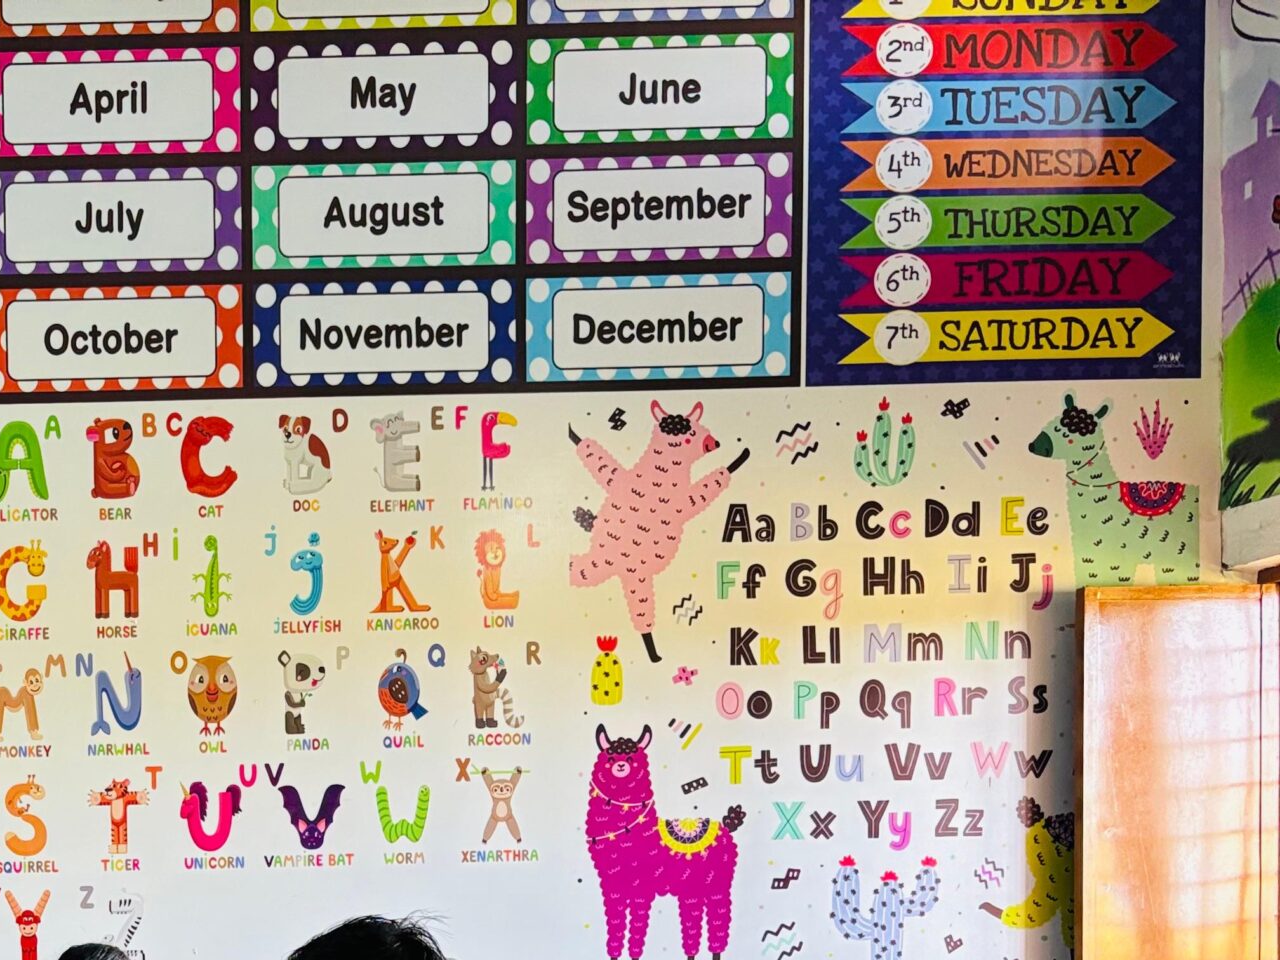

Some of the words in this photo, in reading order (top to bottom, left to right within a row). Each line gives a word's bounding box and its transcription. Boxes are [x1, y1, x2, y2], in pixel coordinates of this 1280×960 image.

[886, 36, 924, 63] 2nd
[944, 29, 1145, 69] MONDAY
[70, 81, 147, 123] April
[351, 76, 416, 116] May
[619, 73, 701, 105] June
[886, 93, 923, 118] 3rd
[940, 85, 1145, 125] TUESDAY
[888, 151, 921, 178] 4th
[944, 149, 1142, 178] WEDNESDAY
[76, 201, 143, 240] July
[324, 196, 443, 235] August
[568, 188, 751, 230] September
[888, 208, 921, 235] 5th
[944, 205, 1140, 239] THURSDAY
[885, 265, 920, 292] 6th
[954, 256, 1131, 297] FRIDAY
[44, 323, 178, 355] October
[300, 317, 469, 350] November
[574, 311, 743, 344] December
[885, 323, 919, 349] 7th
[939, 317, 1143, 351] SATURDAY
[99, 508, 132, 520] BEAR
[198, 505, 224, 518] CAT
[370, 499, 435, 512] ELEPHANT
[722, 503, 775, 543] Aa
[790, 503, 838, 542] Bb
[855, 500, 912, 540] Cc
[925, 499, 980, 538] Dd
[1000, 496, 1049, 536] Ee
[716, 561, 766, 600] Ff
[785, 558, 843, 621] Gg
[863, 556, 925, 596] Hh
[947, 554, 987, 593] Ii
[1010, 552, 1053, 611] Jj
[97, 625, 137, 638] HORSE
[730, 627, 780, 666] Kk
[802, 625, 841, 665] Ll
[864, 623, 943, 663] Mm
[965, 620, 1032, 660] Nn
[715, 682, 772, 720] Oo
[793, 680, 840, 729] Pp
[859, 679, 912, 729] Qq
[934, 677, 988, 717] Rr
[1007, 676, 1048, 715] Ss
[88, 743, 150, 756] NARWHAL
[199, 741, 227, 753] OWL
[468, 733, 531, 746] RACCOON
[719, 745, 780, 784] Tt
[800, 743, 864, 782] Uu
[885, 742, 952, 781] Vv
[970, 741, 1053, 780] Ww
[772, 801, 836, 840] Xx
[857, 800, 912, 850] Yy
[934, 798, 985, 837] Zz
[329, 853, 354, 866] BAT
[384, 852, 424, 864] WORM
[462, 849, 538, 863] XENARTHRA
